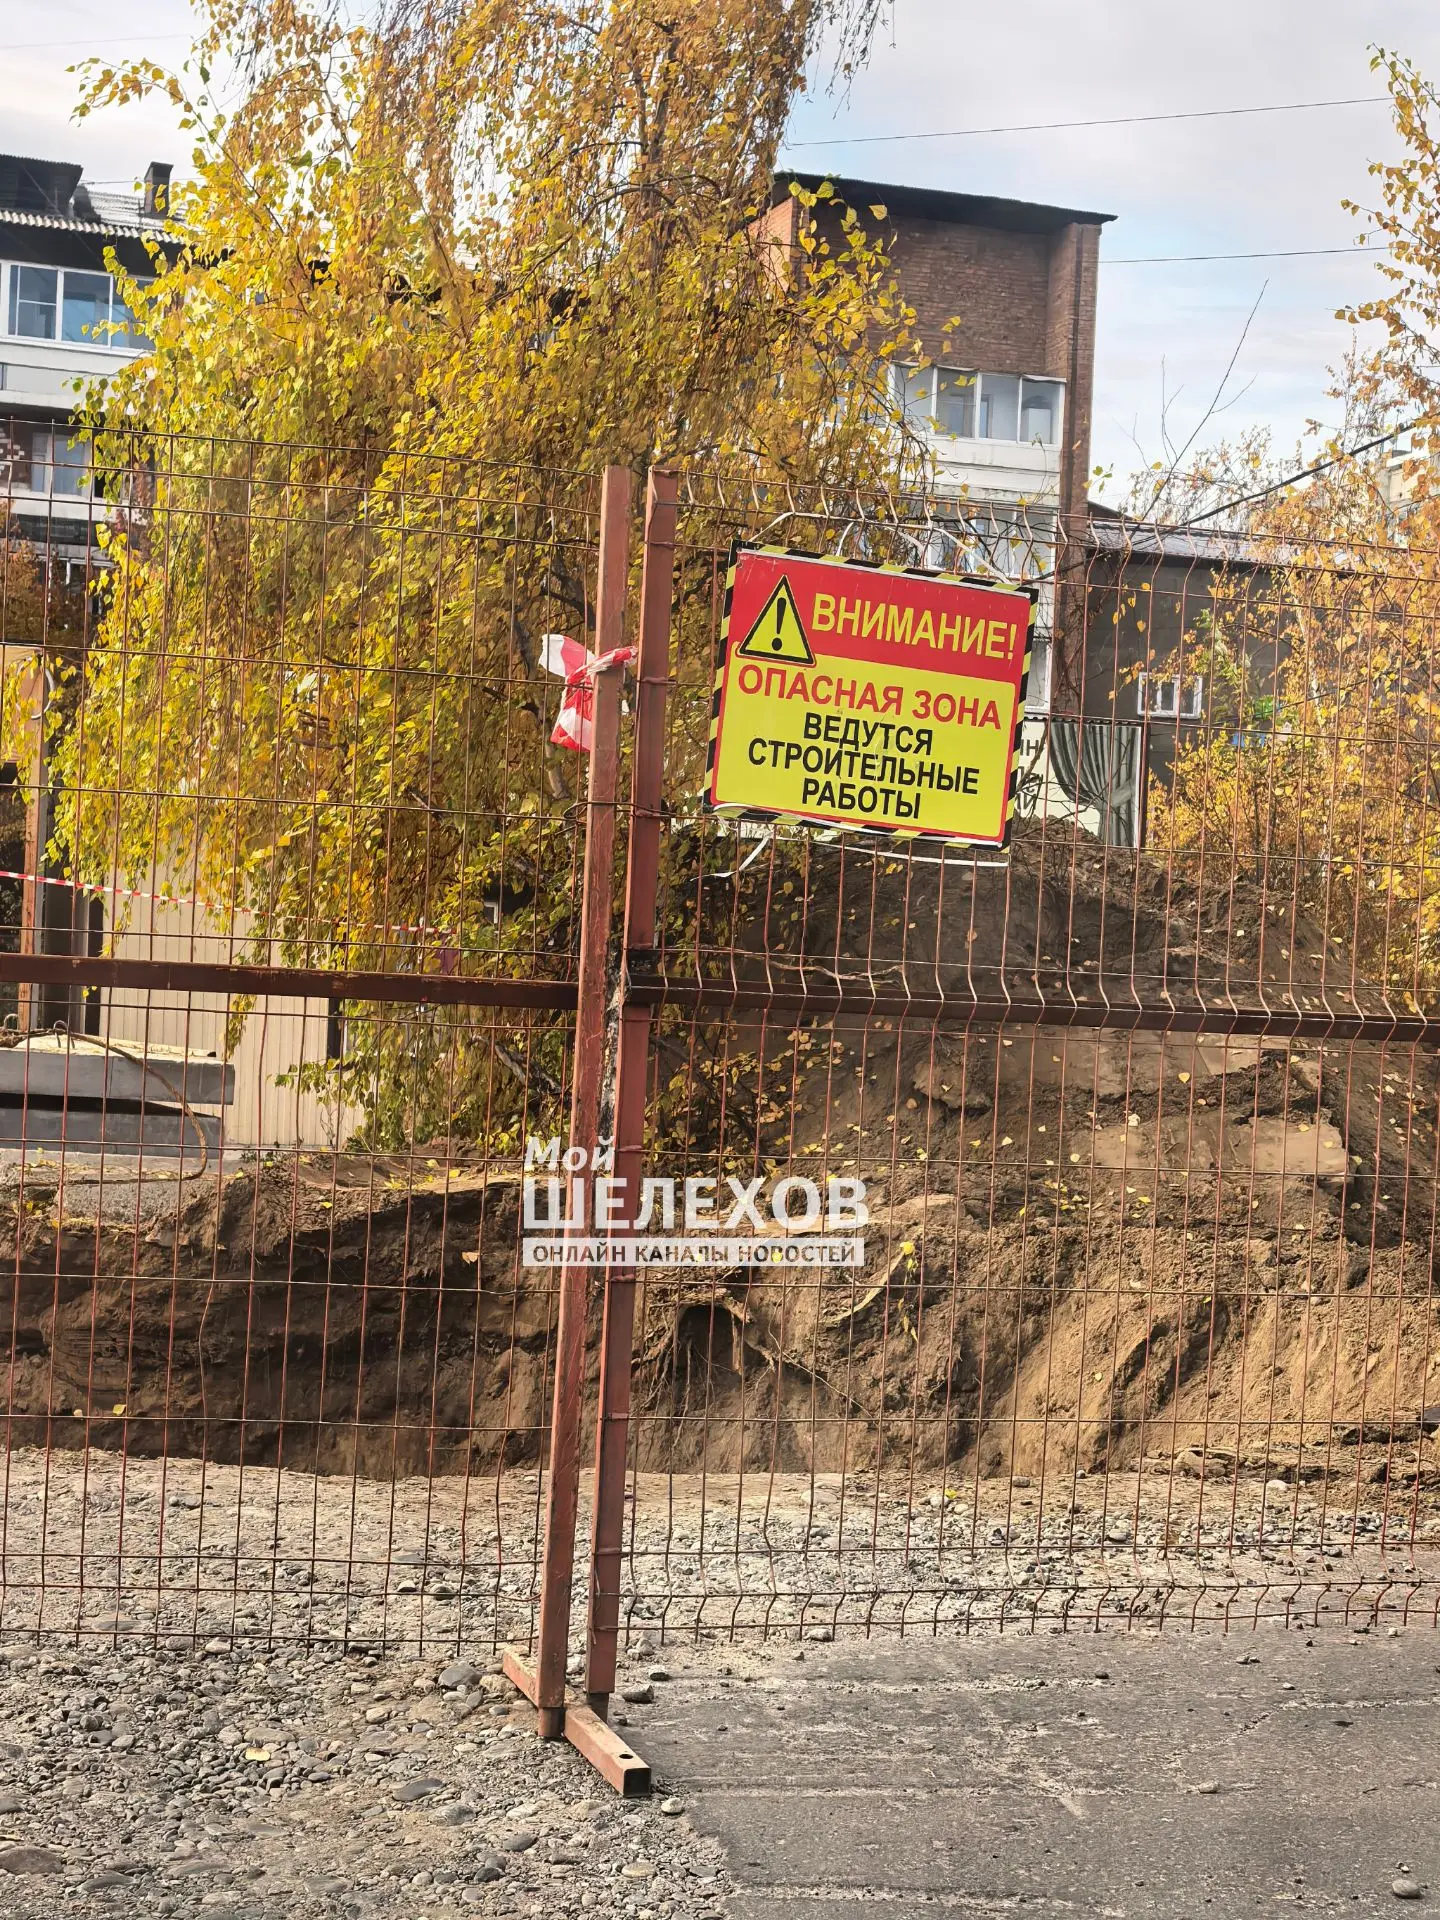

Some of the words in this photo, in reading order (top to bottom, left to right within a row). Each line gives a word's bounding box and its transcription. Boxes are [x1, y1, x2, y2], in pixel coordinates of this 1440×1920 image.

[811, 592, 1018, 661] ВНИМАНИЕ!
[738, 664, 904, 716] ОПАСНАЯ
[912, 690, 1002, 730] ЗОНА
[803, 712, 934, 756] ВЕДУТСЯ
[748, 737, 980, 795] СТРОИТЕЛЬНЫЕ
[801, 777, 922, 820] РАБОТЫ
